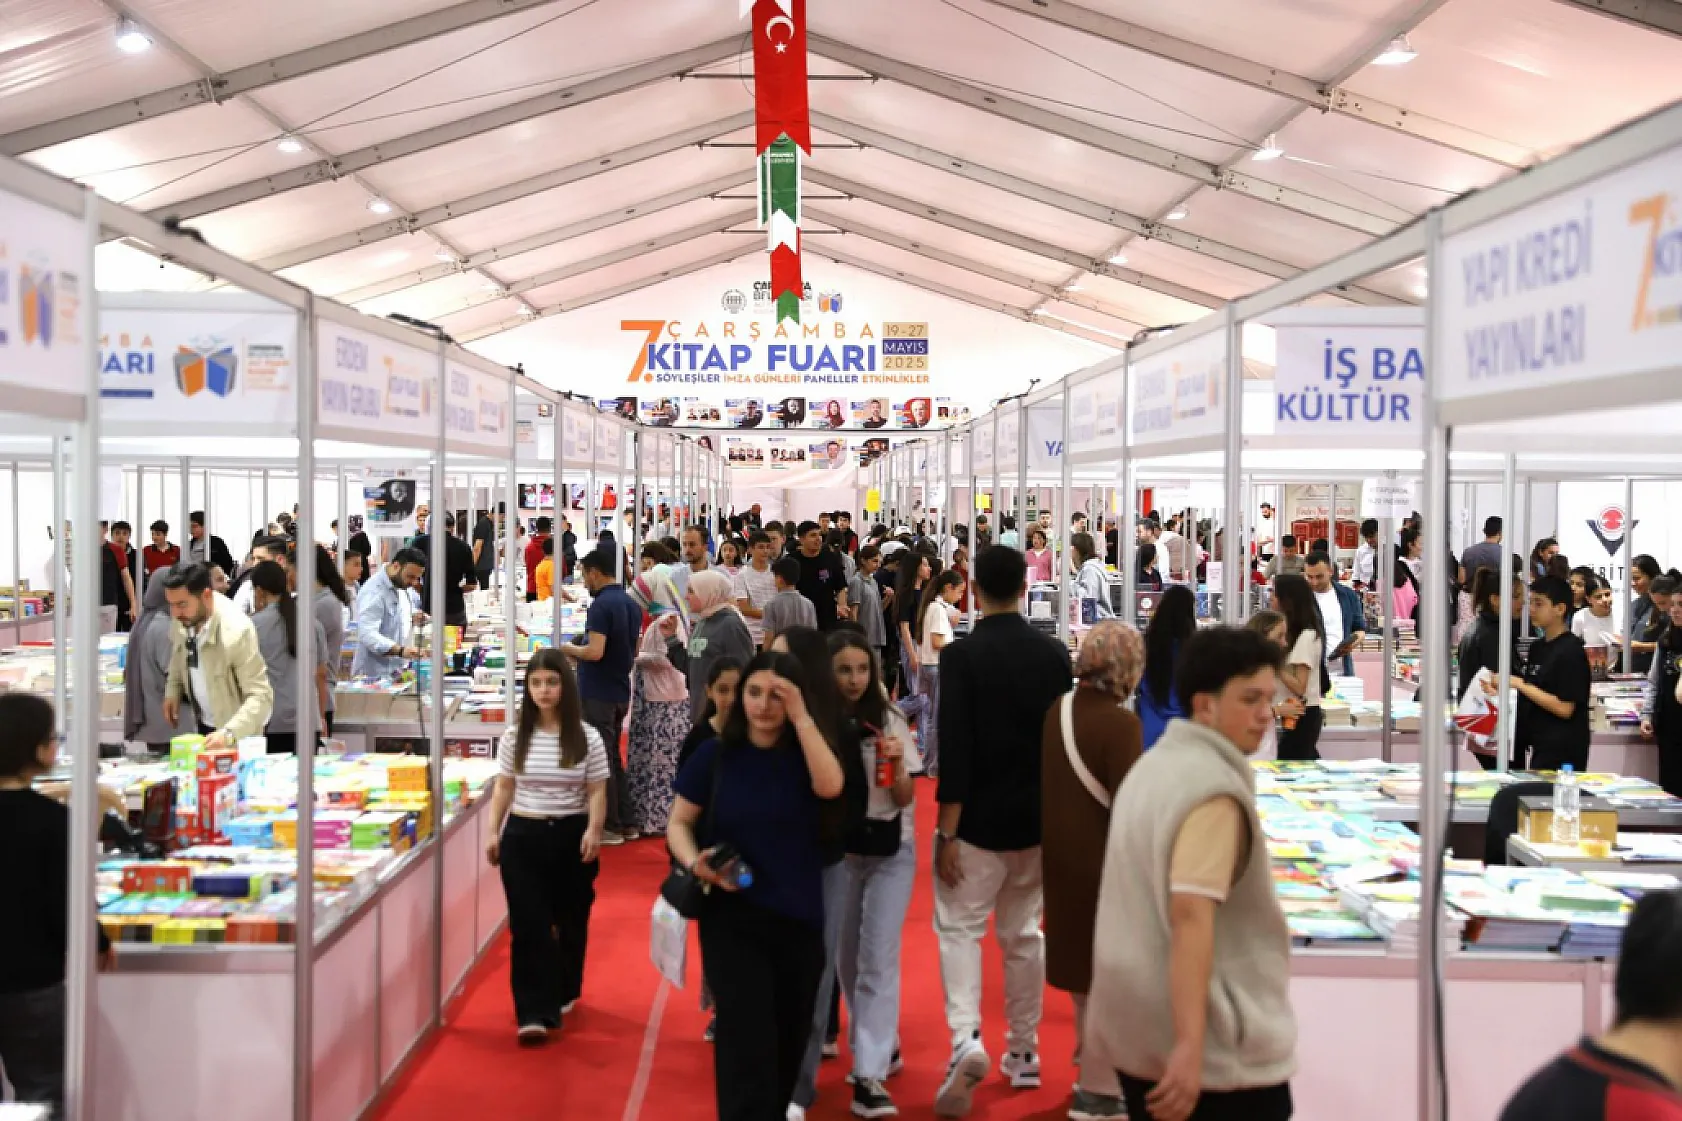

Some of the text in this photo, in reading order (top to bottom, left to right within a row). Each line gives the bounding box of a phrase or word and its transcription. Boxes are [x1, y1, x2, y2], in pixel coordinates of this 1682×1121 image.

[1461, 197, 1593, 307] YAPI KREDİ
[668, 321, 874, 342] ÇARŞAMBA
[884, 341, 926, 354] MAYIS
[1464, 304, 1586, 381] YAYINLARI
[621, 320, 665, 383] 7.
[648, 342, 876, 372] KİTAP FUARI
[885, 357, 925, 369] 2025
[1324, 338, 1358, 389] İŞ
[656, 371, 930, 385] SÖYLEŞİLER İMZA GÜNLERİ PANELLER ETKİNLİKLER
[1277, 386, 1411, 421] KÜLTÜR
